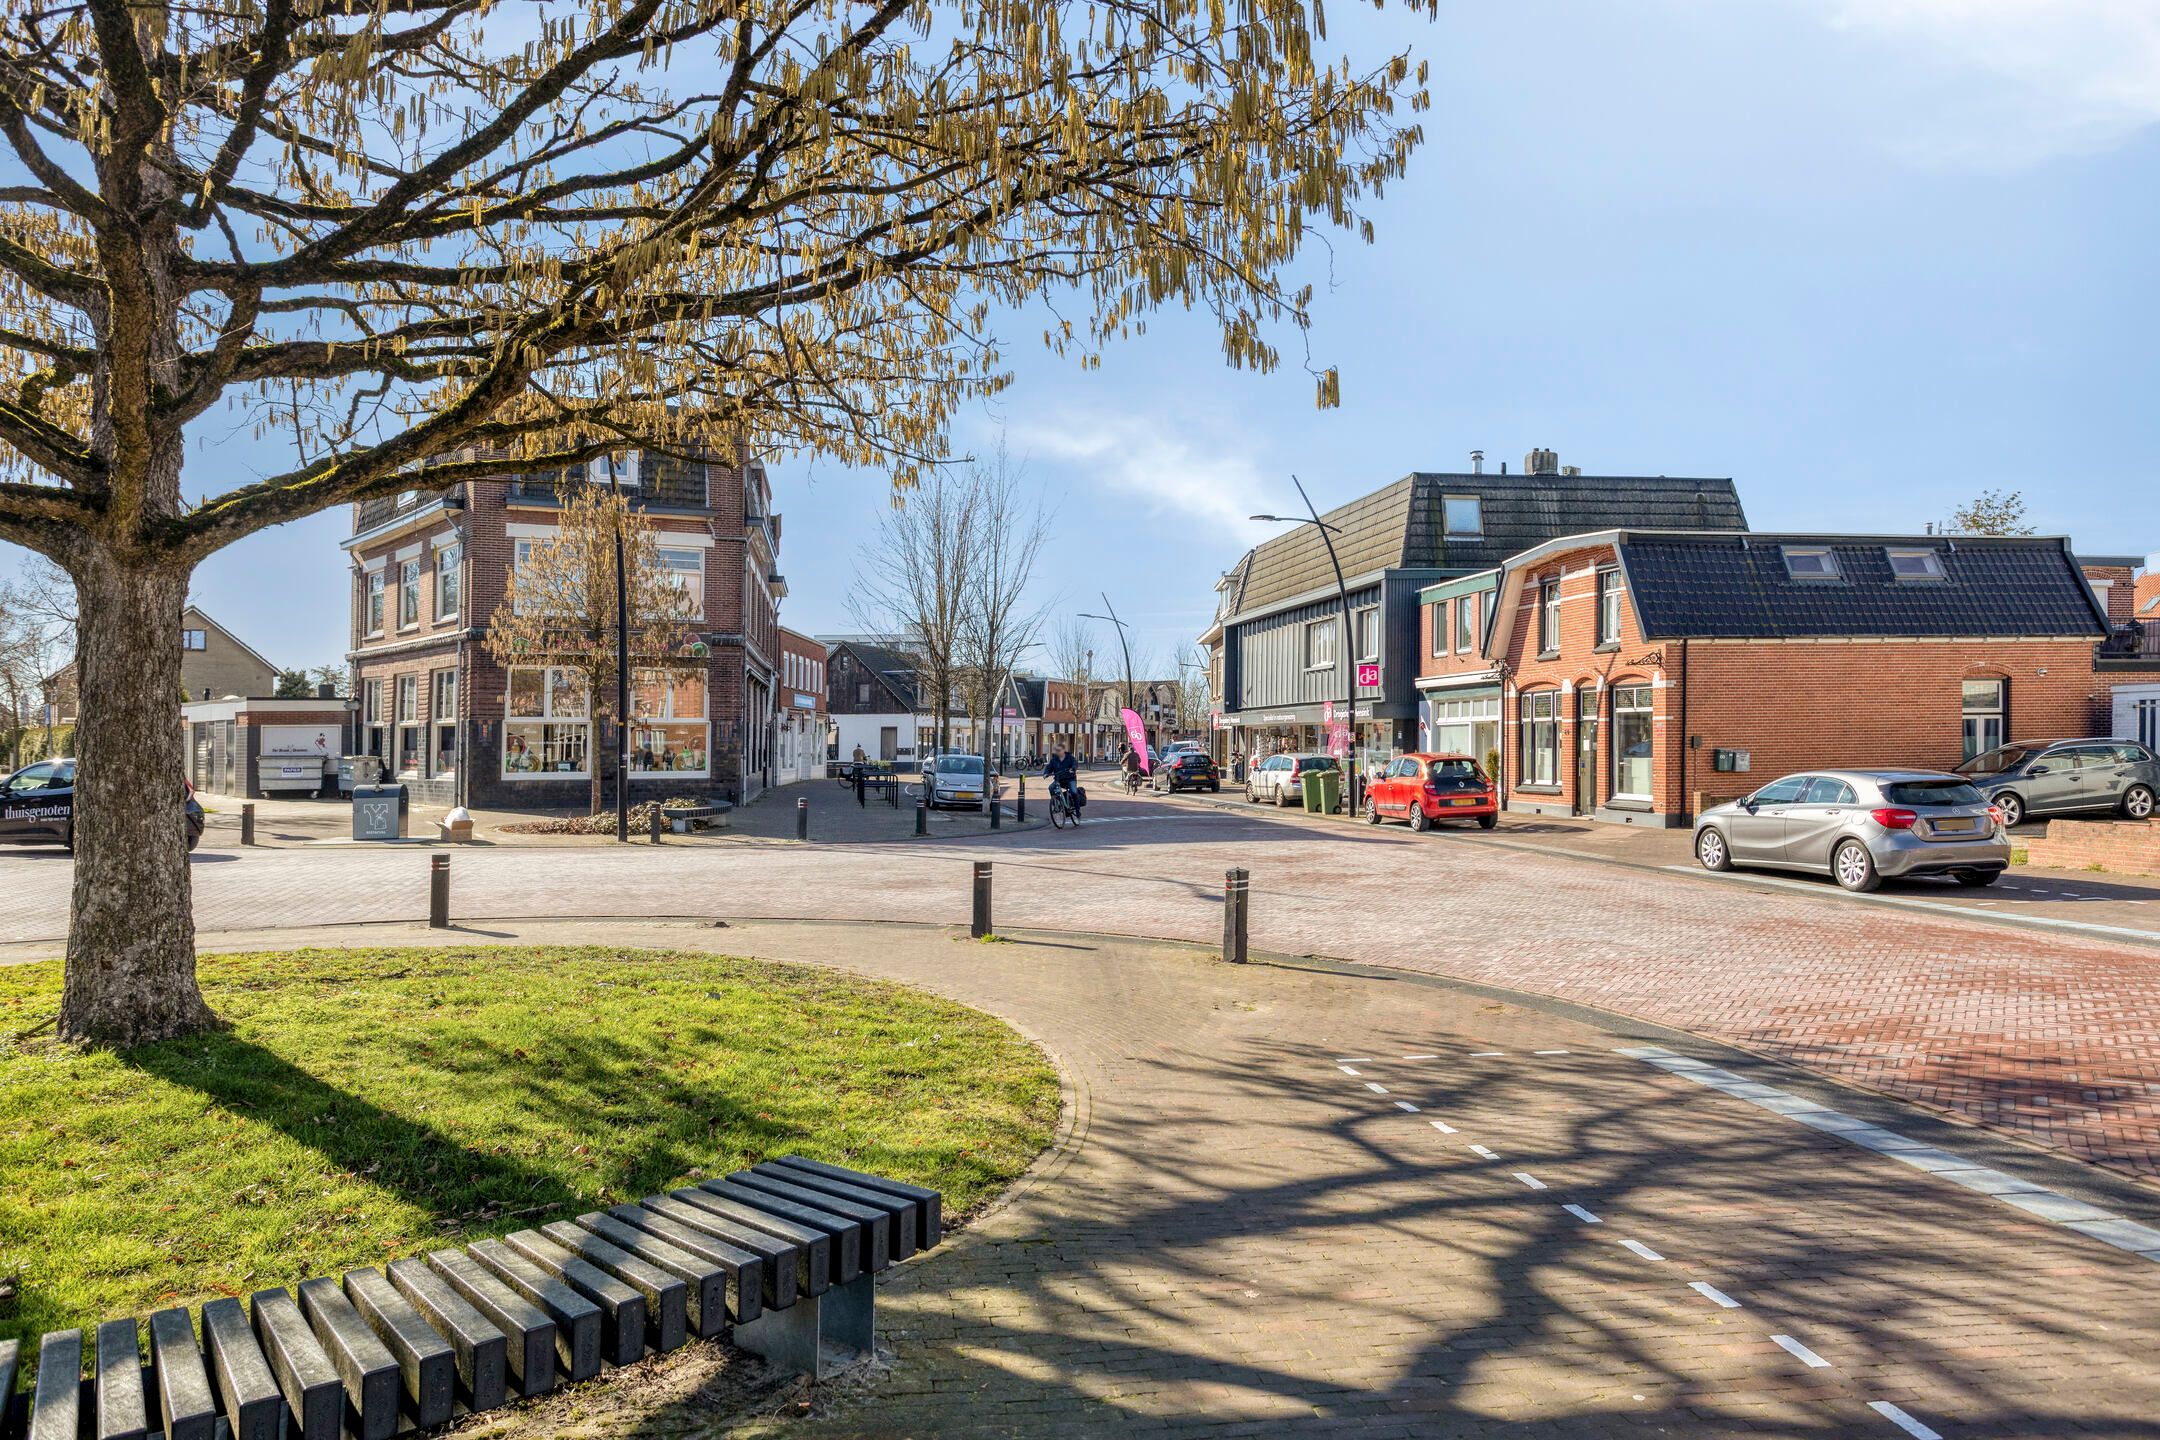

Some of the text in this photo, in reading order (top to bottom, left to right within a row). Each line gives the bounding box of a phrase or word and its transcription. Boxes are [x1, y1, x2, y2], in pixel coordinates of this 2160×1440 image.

[1360, 668, 1378, 684] da
[1324, 704, 1332, 722] da
[5, 805, 70, 823] thuisgenoten
